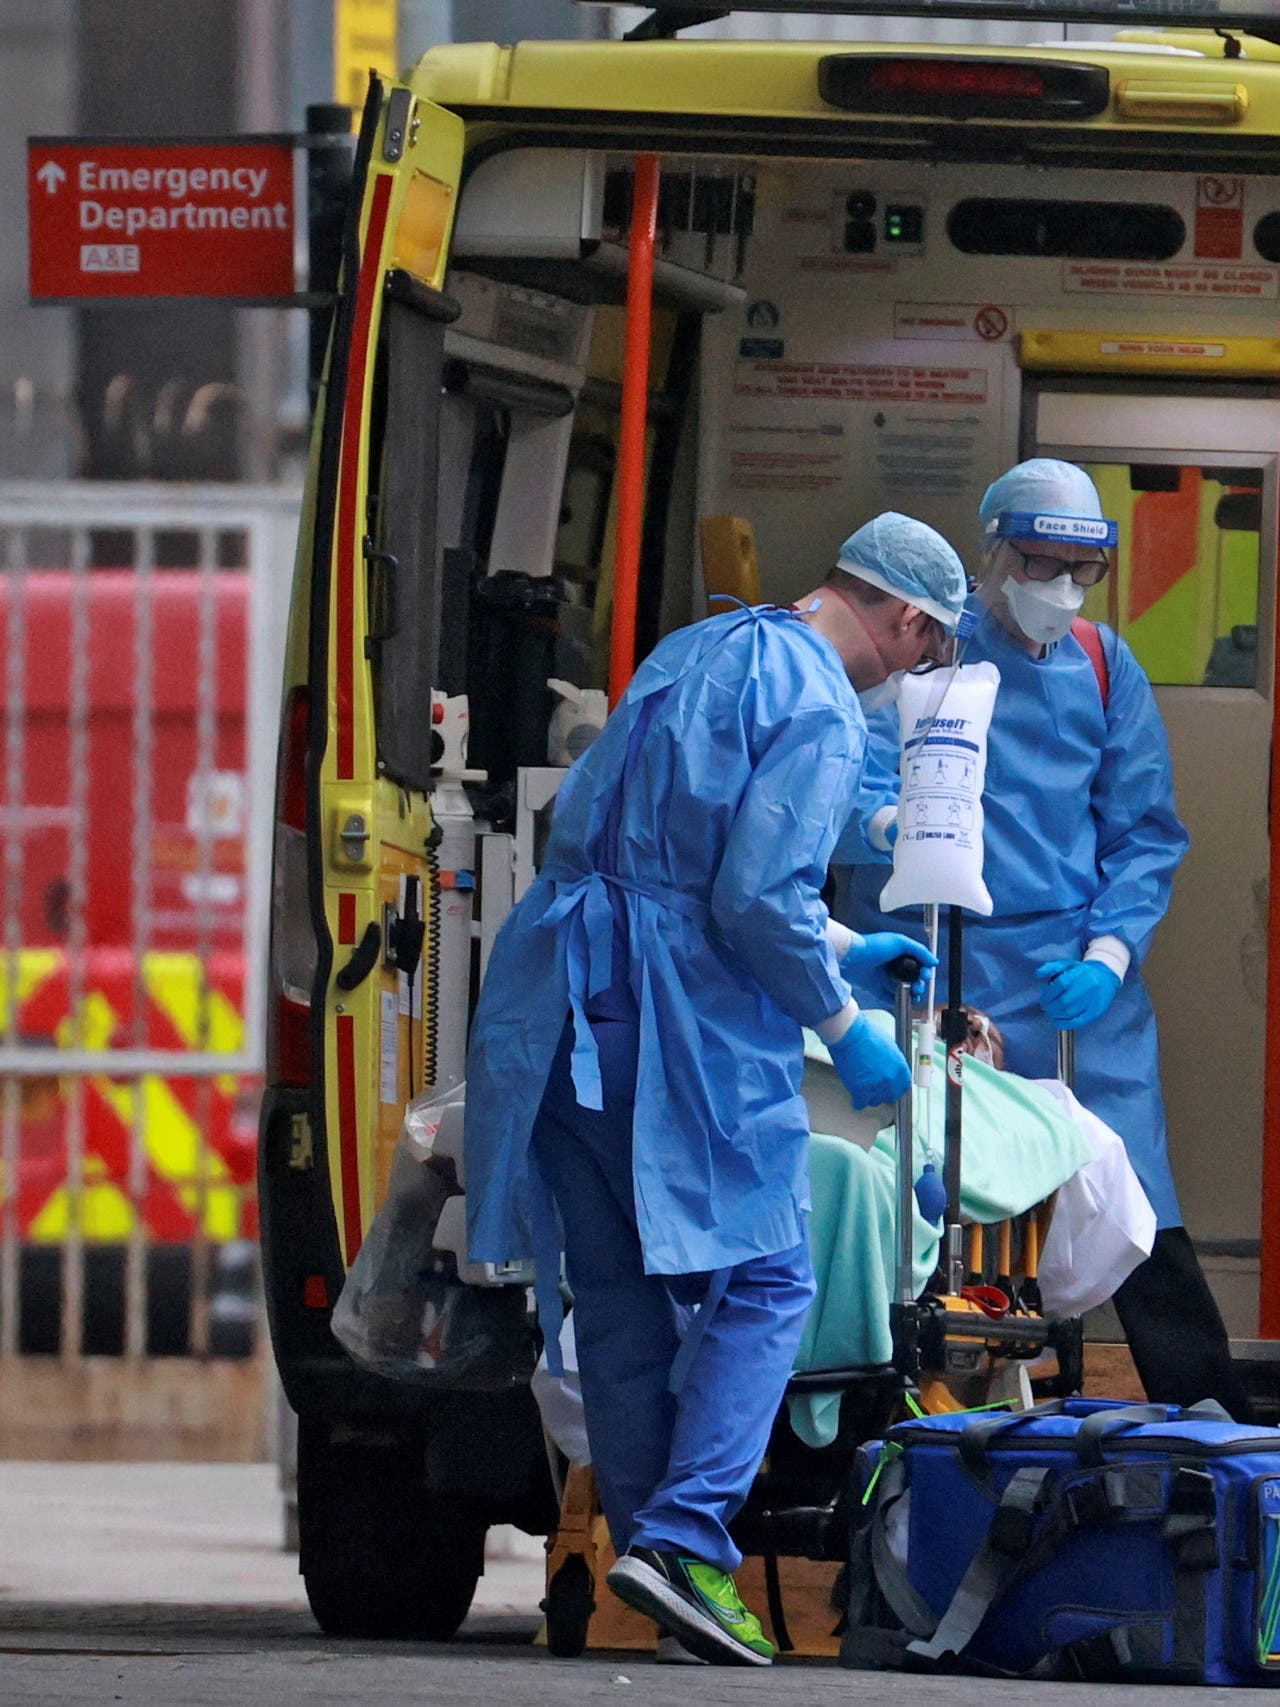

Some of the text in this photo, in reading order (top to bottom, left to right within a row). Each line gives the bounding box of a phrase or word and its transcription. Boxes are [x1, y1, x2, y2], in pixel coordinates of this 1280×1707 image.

[79, 161, 268, 198] Emergency
[80, 200, 288, 236] Department
[86, 247, 137, 267] A&E
[1223, 270, 1273, 281] CLOSED
[1039, 520, 1104, 535] Face Shield
